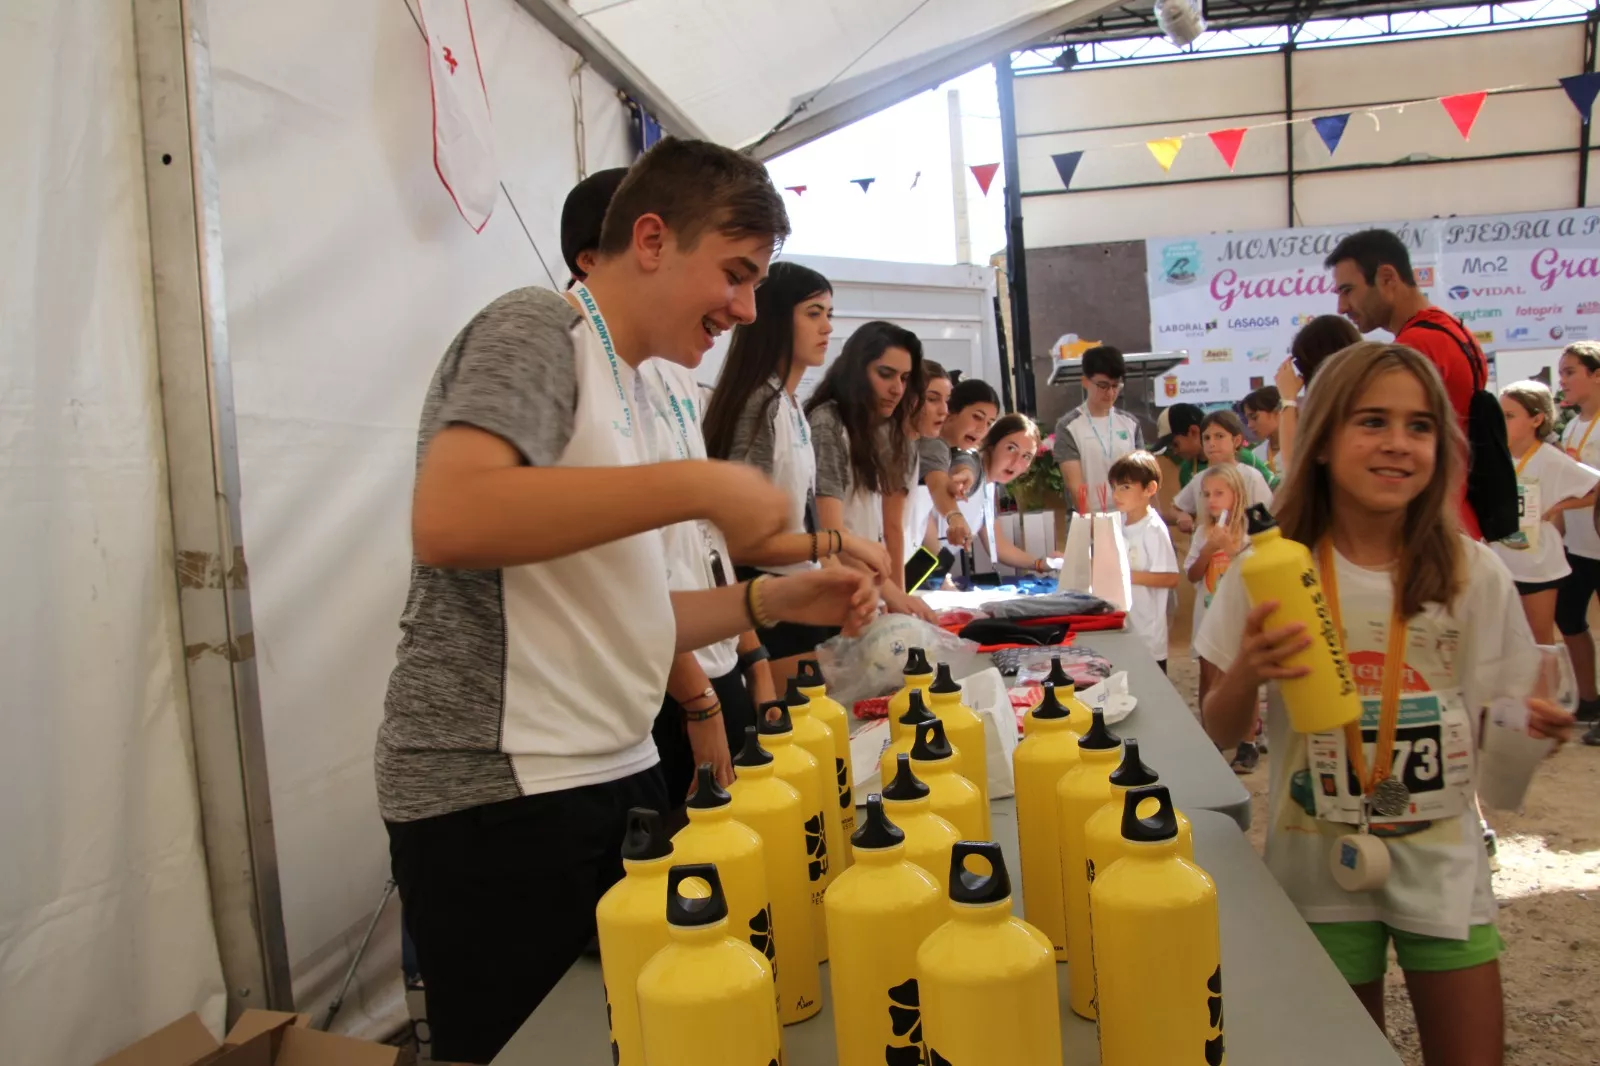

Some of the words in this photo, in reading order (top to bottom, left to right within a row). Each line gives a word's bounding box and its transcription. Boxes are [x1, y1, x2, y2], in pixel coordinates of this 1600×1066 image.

[1447, 218, 1550, 245] PIEDRA
[1557, 216, 1577, 237] A
[1217, 222, 1428, 262] MONTEAÓN
[1472, 286, 1526, 297] VIDAL
[577, 287, 596, 314] TRAIL
[1516, 304, 1563, 316] fotoprix
[1159, 322, 1204, 333] LABORAL
[1228, 316, 1279, 329] LASAOSA
